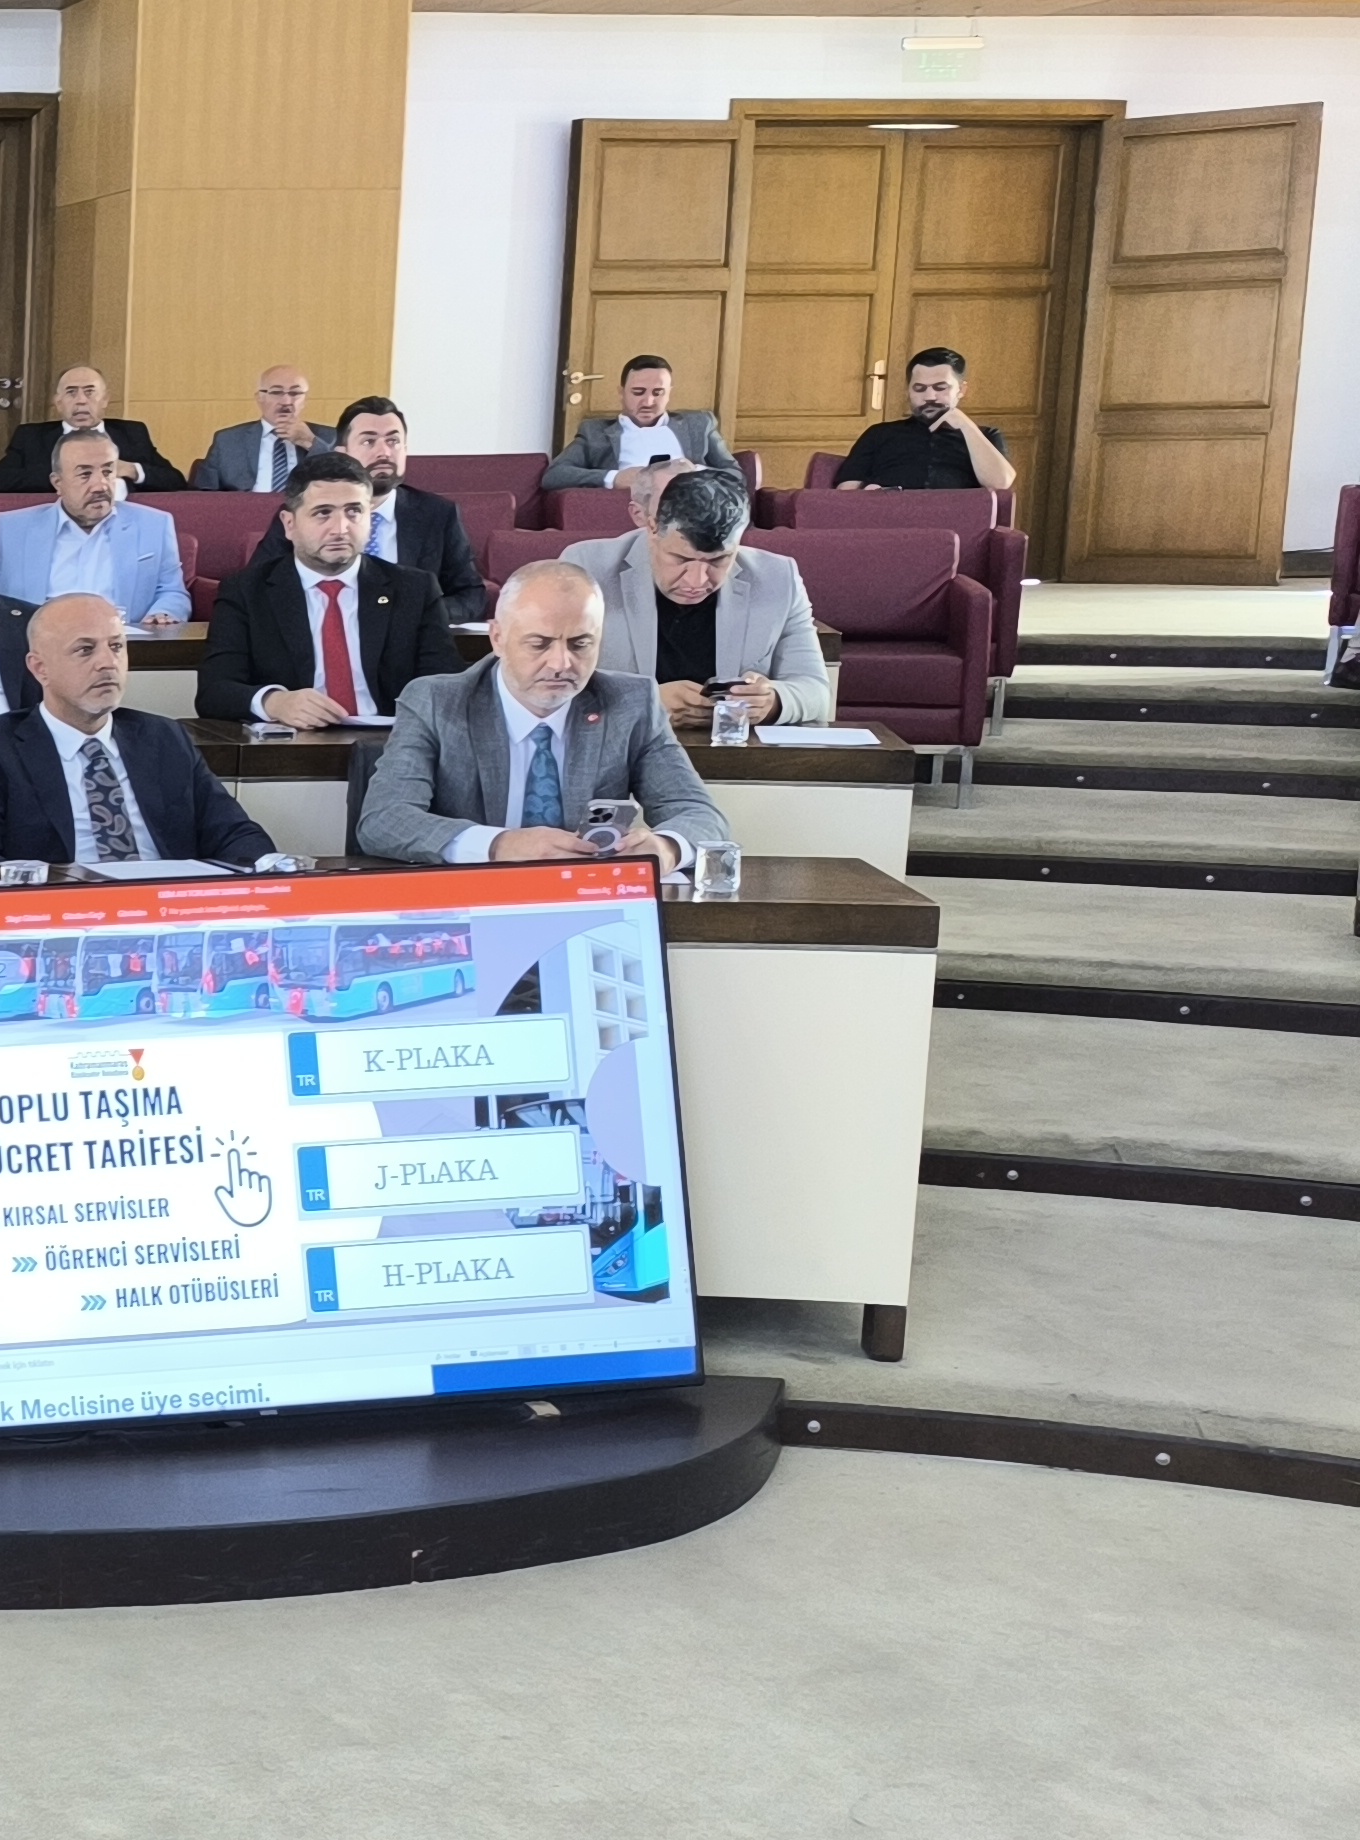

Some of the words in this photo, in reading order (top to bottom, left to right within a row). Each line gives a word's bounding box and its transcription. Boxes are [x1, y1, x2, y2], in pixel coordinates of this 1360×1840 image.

[363, 1044, 494, 1073] K-PLAKA
[296, 1074, 316, 1087] TR
[79, 1086, 183, 1127] TAŞIMA
[83, 1125, 204, 1169] TARİFESİ
[374, 1158, 499, 1190] J-PLAKA
[2, 1204, 68, 1227] KIRSAL
[74, 1195, 170, 1223] SERVİSLER
[306, 1188, 326, 1202] TR
[45, 1240, 128, 1271] ÖĞRENCİ
[134, 1233, 241, 1265] SERVİSLERİ
[381, 1257, 514, 1288] H-PLAKA
[115, 1285, 163, 1308] HALK
[169, 1273, 279, 1304] OTÜBÜSLERİ
[314, 1289, 335, 1303] TR
[20, 1394, 135, 1421] Meclisine
[140, 1391, 182, 1416] üye
[189, 1383, 271, 1409] seçimi.
